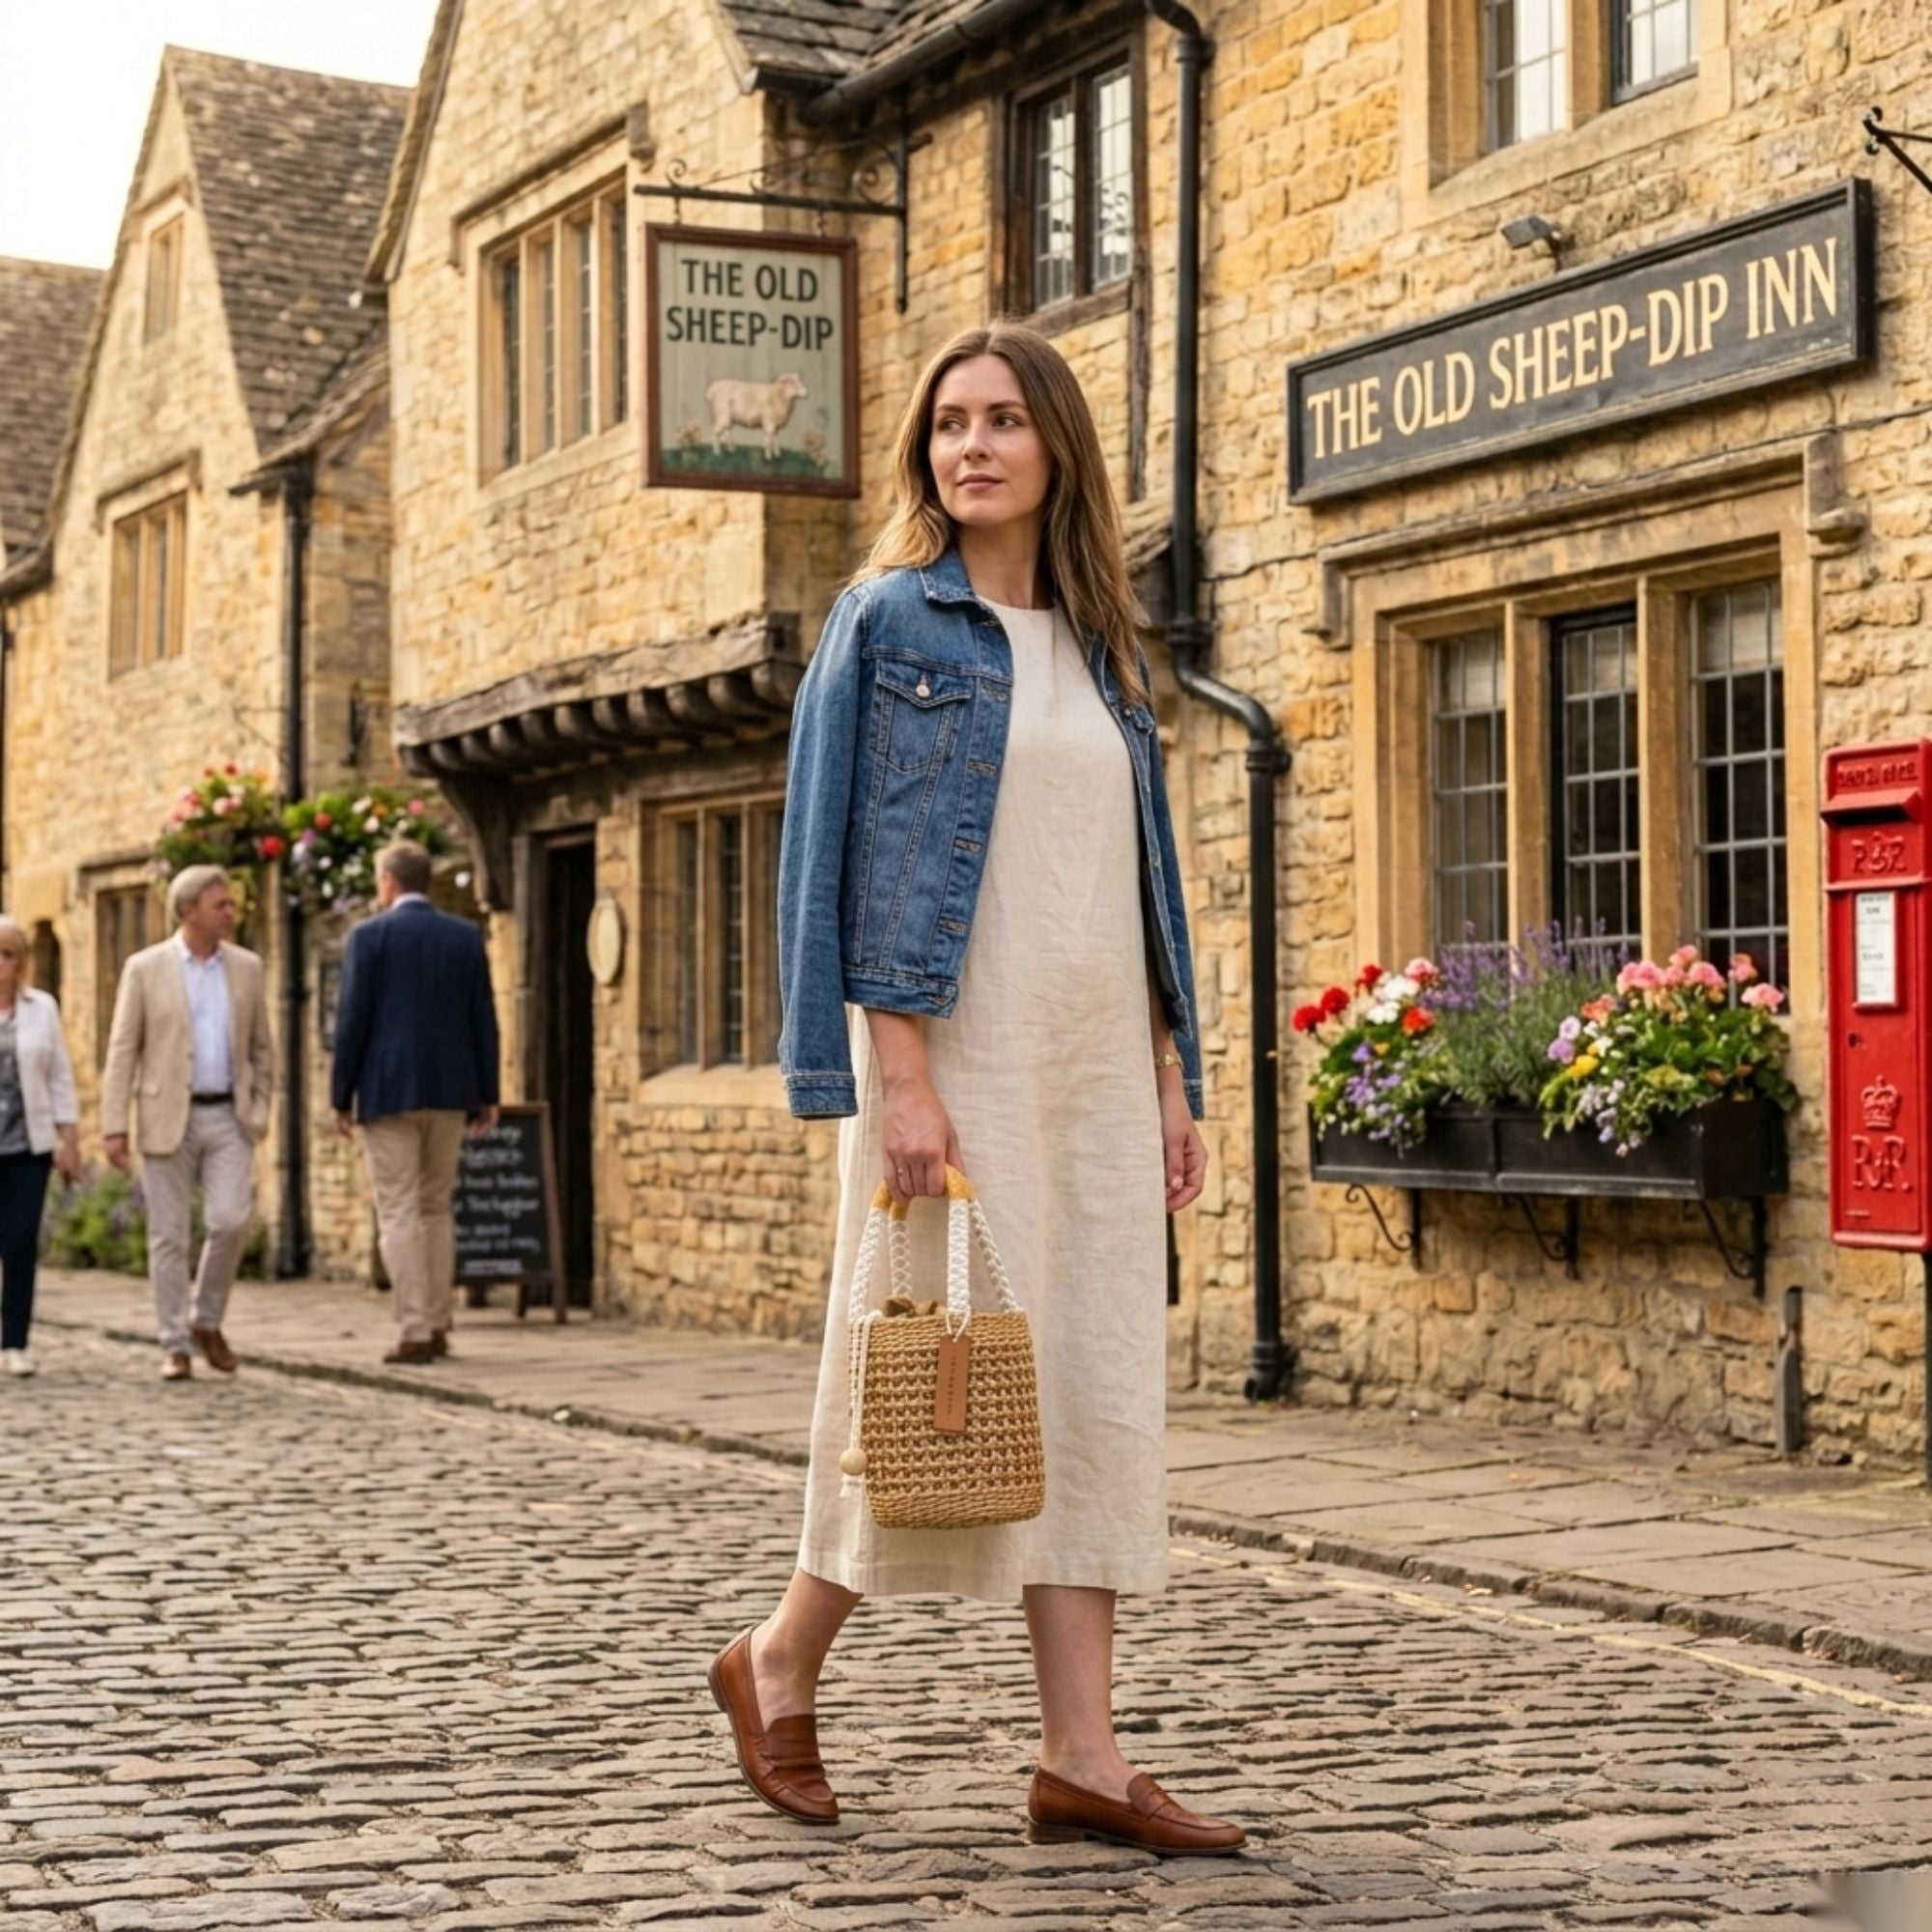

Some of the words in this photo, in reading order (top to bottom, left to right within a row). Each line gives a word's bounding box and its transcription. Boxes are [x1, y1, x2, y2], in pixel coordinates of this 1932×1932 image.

[681, 258, 743, 298] THE
[755, 264, 819, 303] OLD
[666, 305, 834, 352] SHEEP-DIP
[1306, 376, 1381, 460] THE
[1393, 350, 1475, 436] OLD
[1489, 271, 1729, 412] SHEEP-DIP
[1746, 237, 1838, 341] INN
